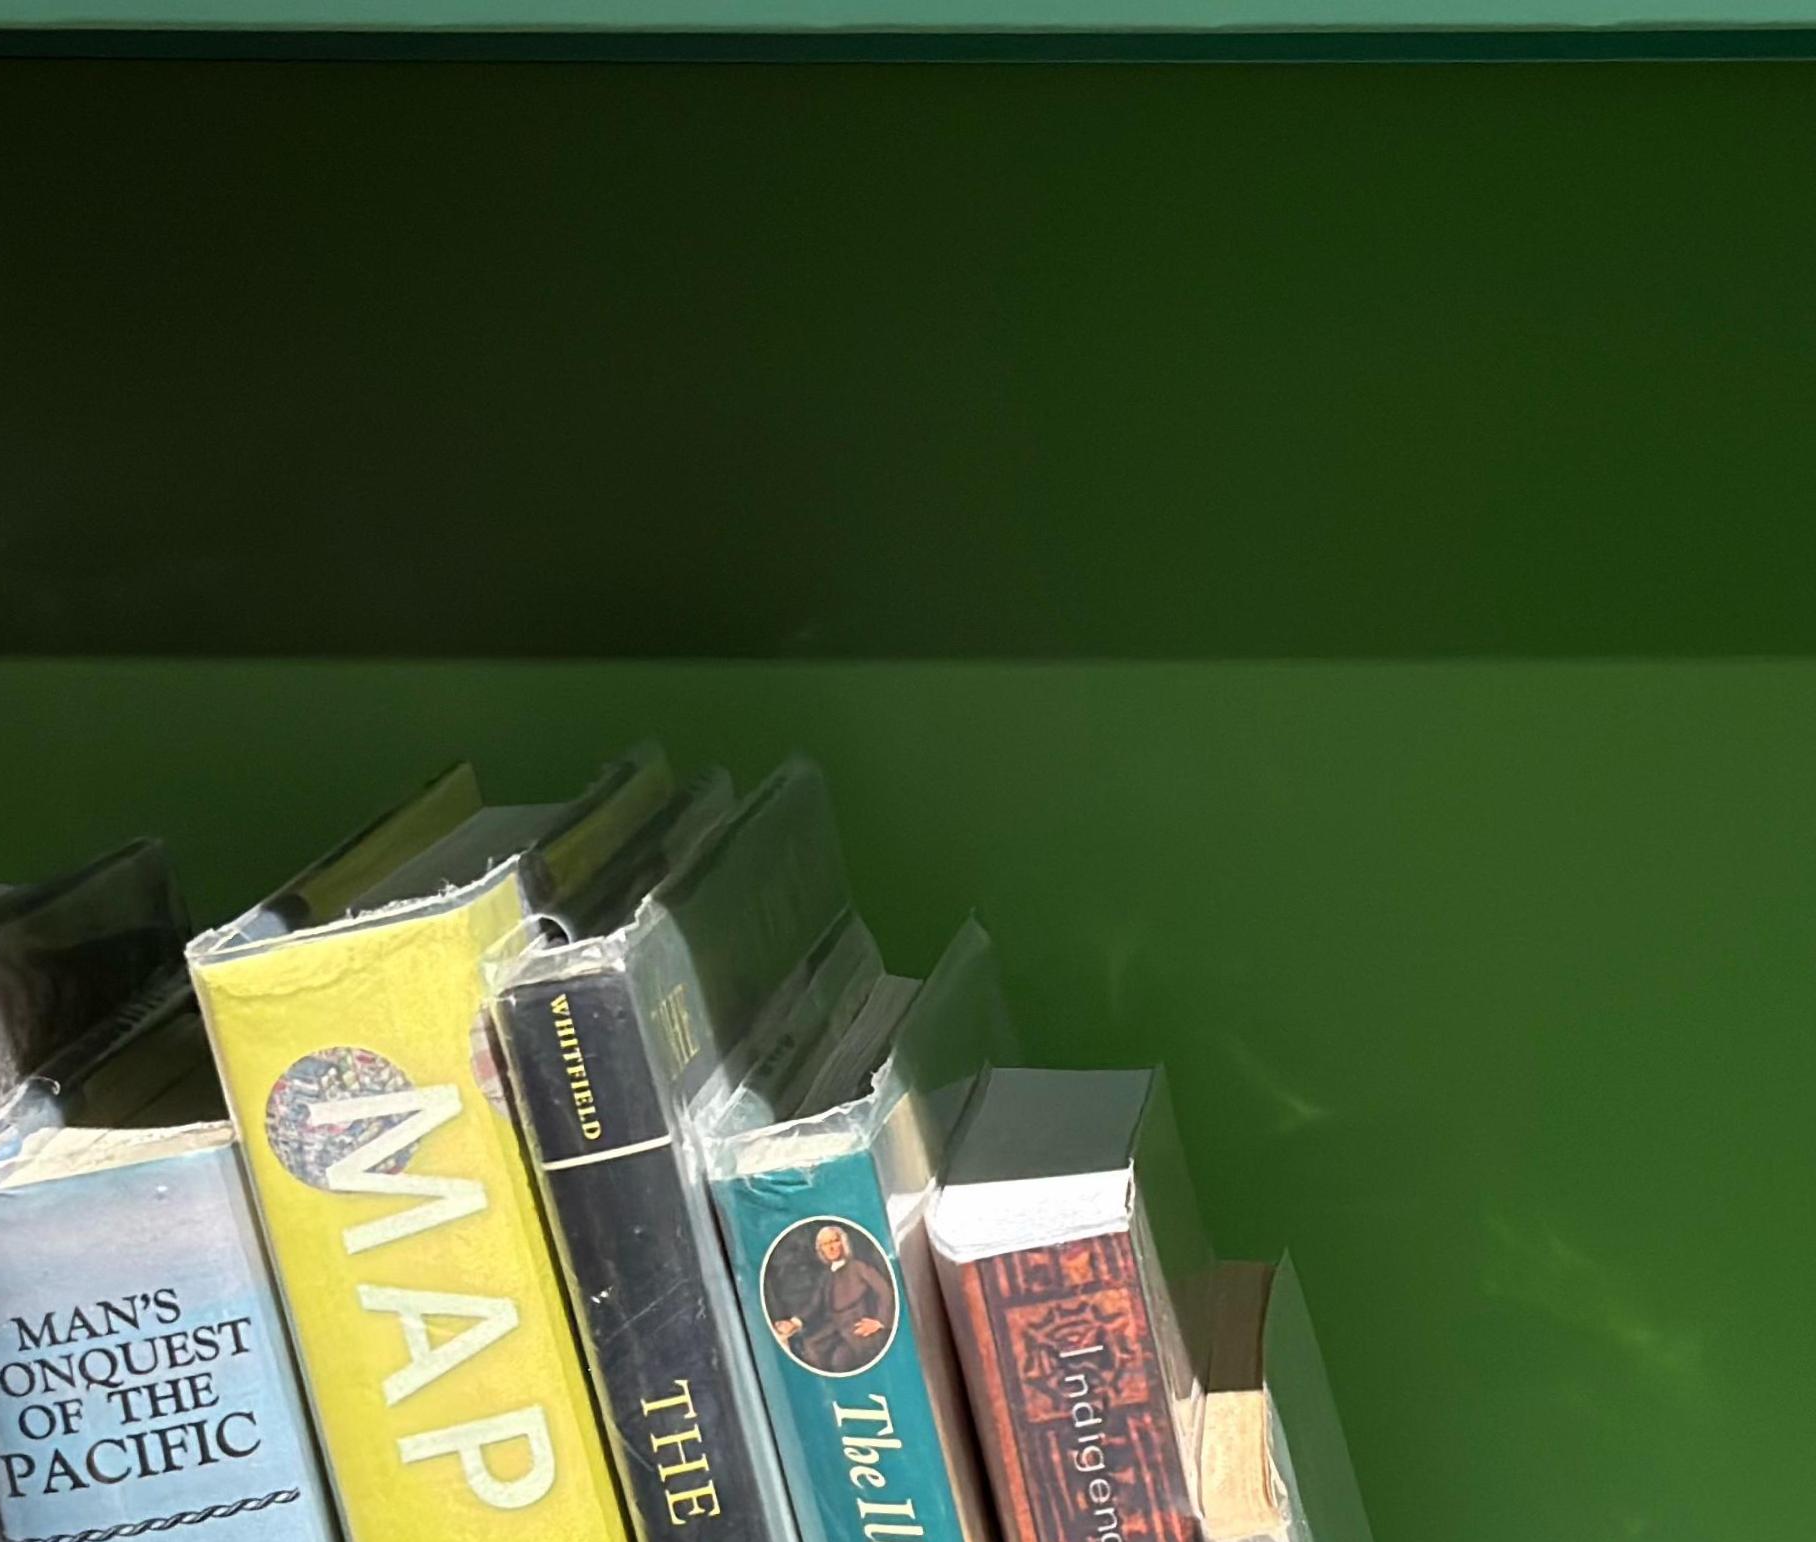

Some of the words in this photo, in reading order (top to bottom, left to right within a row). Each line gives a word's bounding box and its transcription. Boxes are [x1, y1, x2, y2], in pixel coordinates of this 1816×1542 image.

[550, 994, 602, 1141] WHITFIELD
[305, 1083, 558, 1513] MAP
[0, 1411, 263, 1500] PACIFIC
[17, 1399, 92, 1441] OF
[107, 1372, 220, 1428] THE
[640, 1380, 721, 1527] THE
[832, 1393, 904, 1491] The
